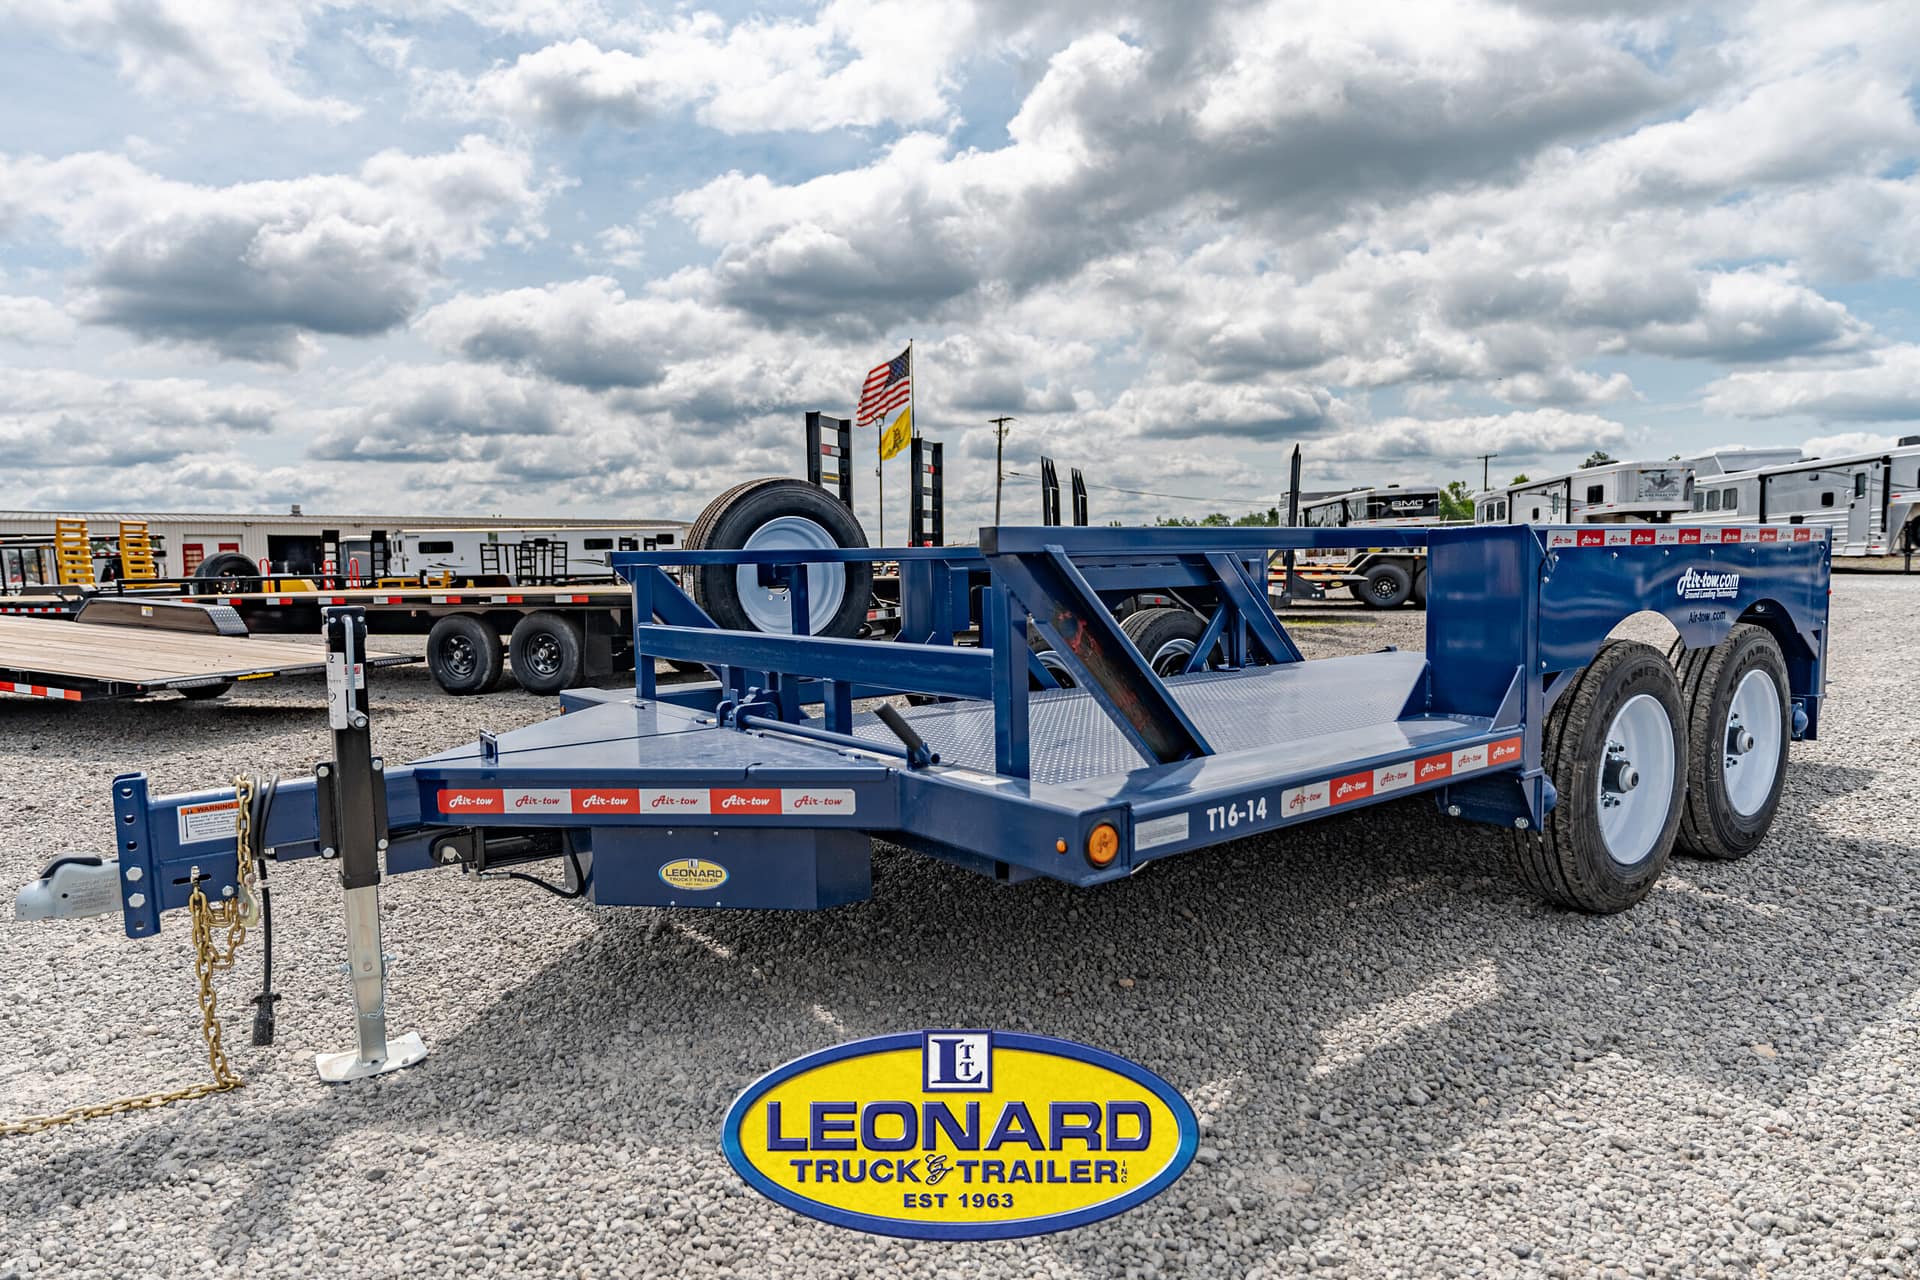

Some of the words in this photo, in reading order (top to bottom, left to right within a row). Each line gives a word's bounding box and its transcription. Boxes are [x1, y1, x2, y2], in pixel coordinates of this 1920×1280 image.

[1676, 567, 1740, 596] Air-tow.com
[1289, 792, 1322, 810] Air-tow
[1336, 782, 1368, 798] Air-tow
[1380, 771, 1409, 787] Air-tow
[1420, 762, 1447, 777] Air-tow
[198, 803, 234, 813] WARNING
[449, 795, 494, 808] Air-tow
[515, 795, 561, 808] Air-tow
[583, 795, 629, 808] Air-tow
[652, 795, 699, 808] Air-tow
[722, 795, 770, 808] Air-tow
[794, 795, 843, 808] Air-tow
[1206, 797, 1268, 831] T16-14
[665, 869, 723, 878] LEONARD
